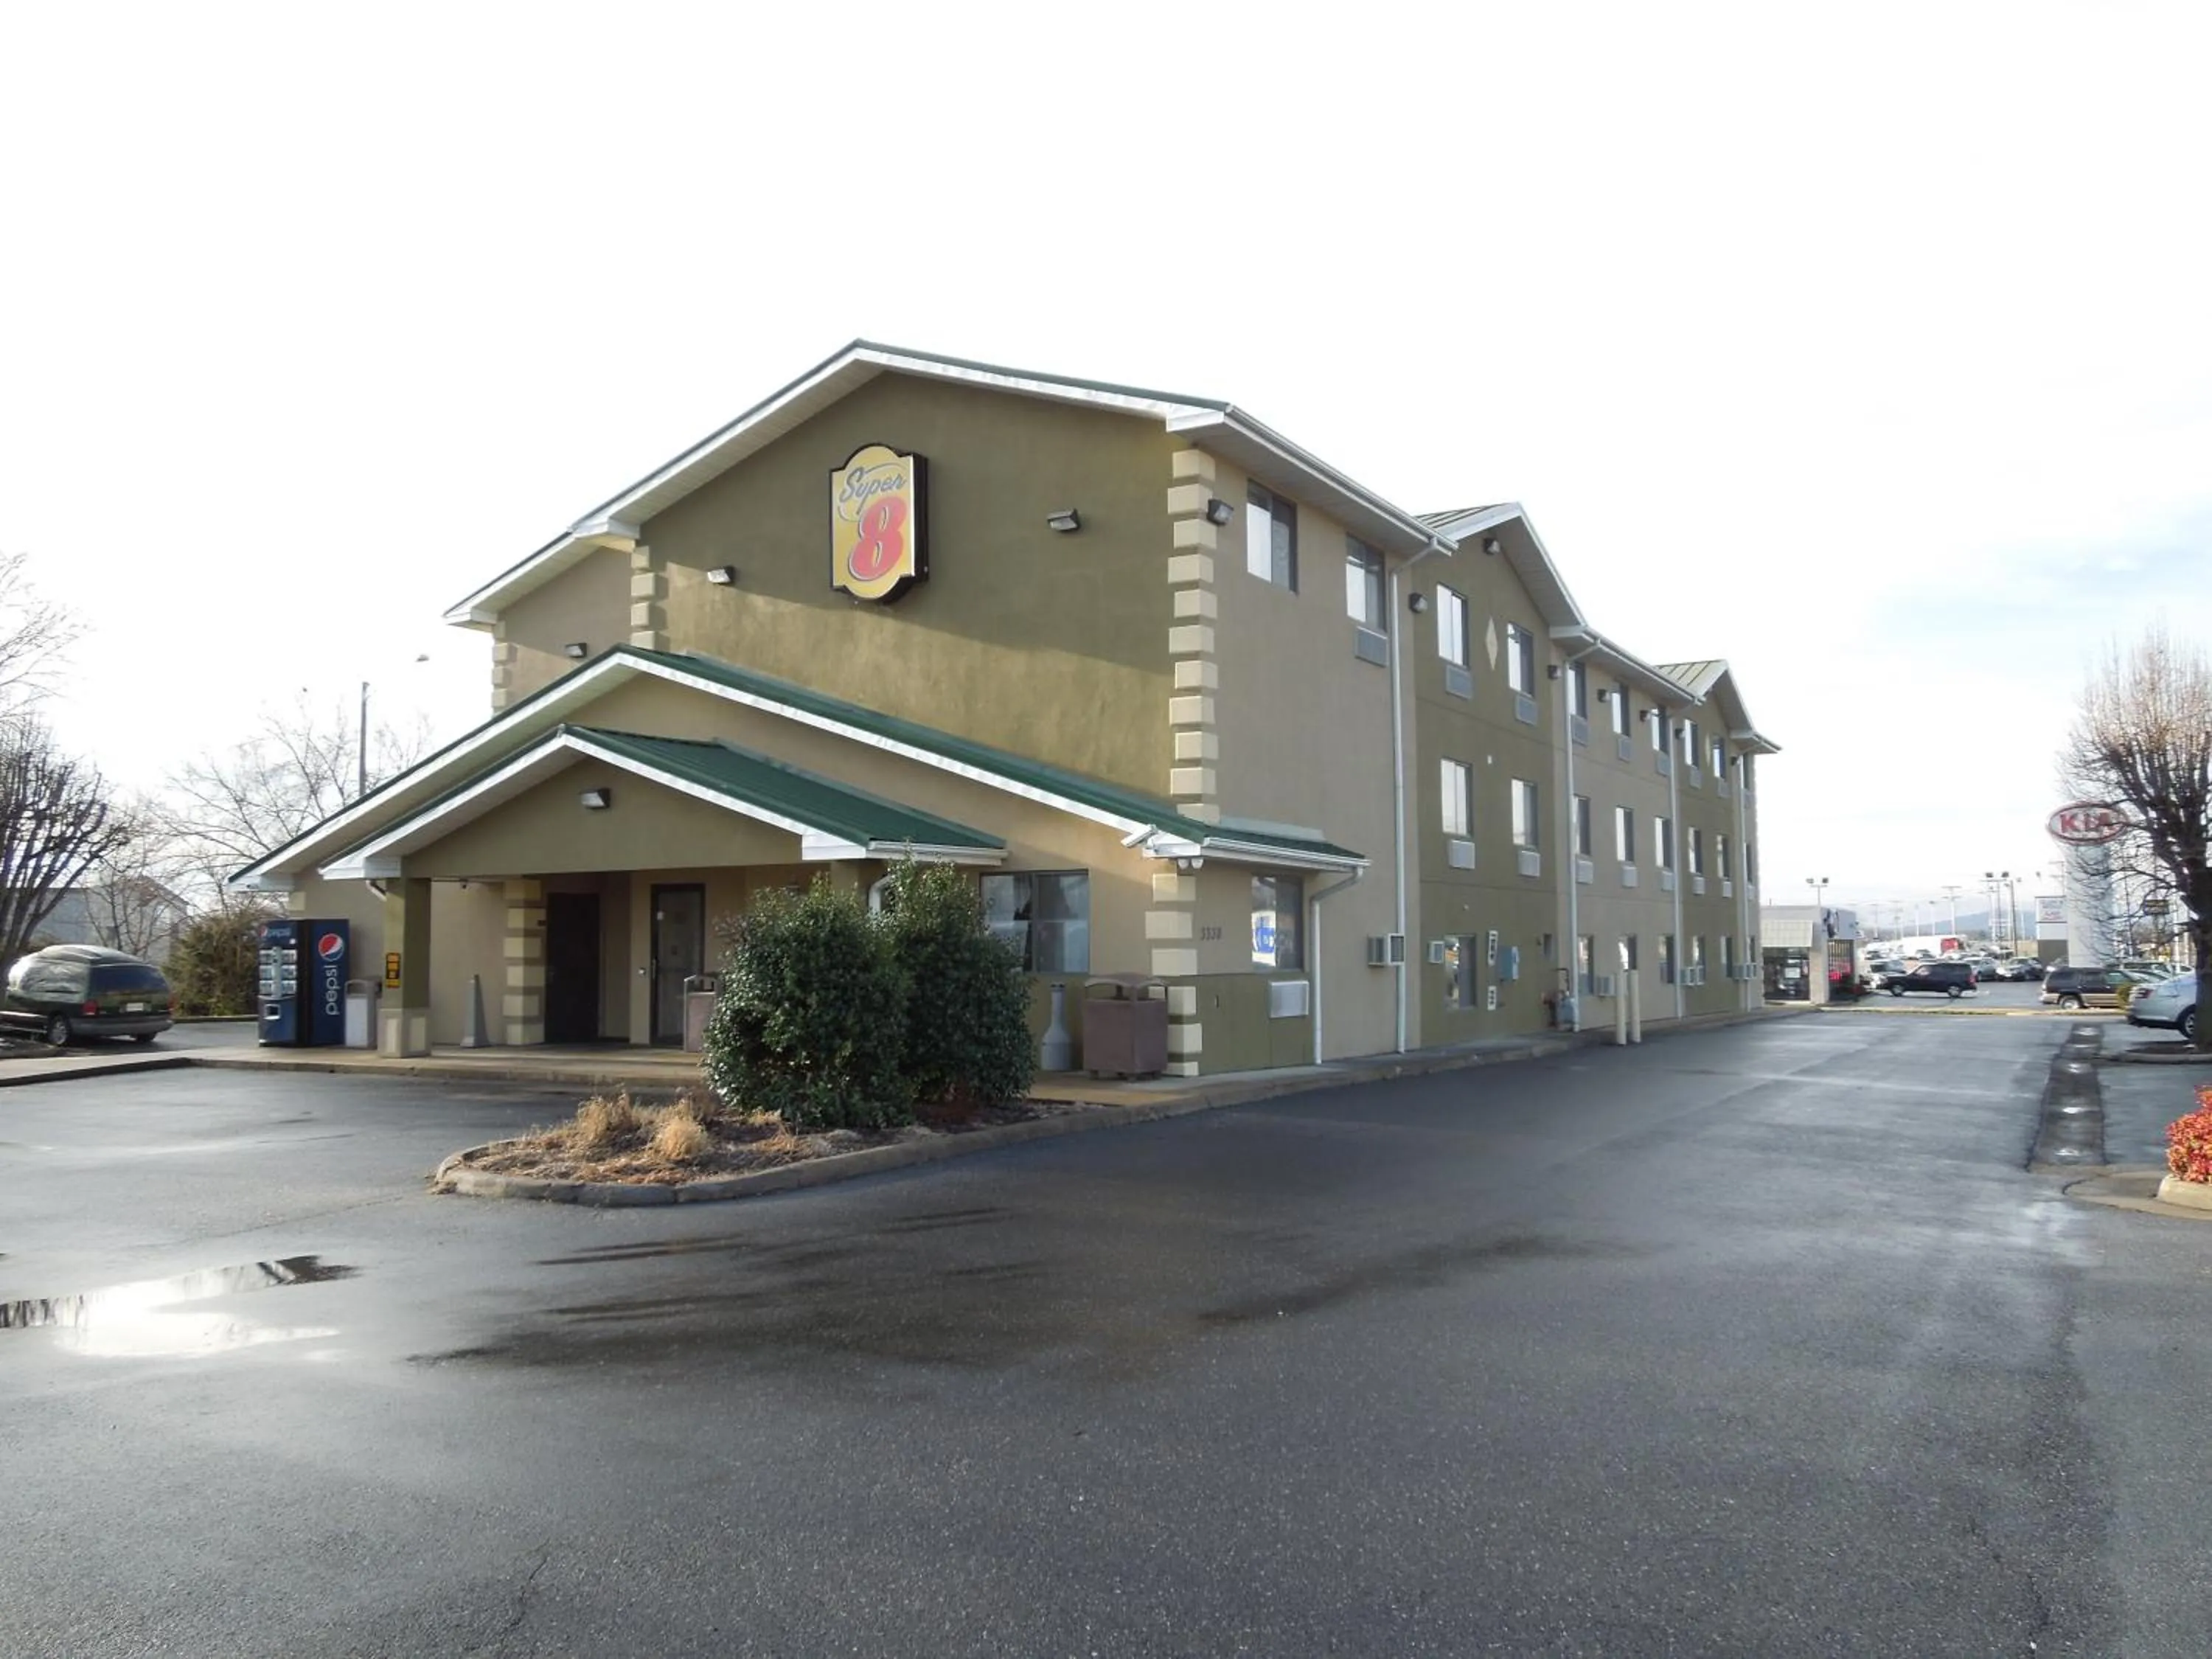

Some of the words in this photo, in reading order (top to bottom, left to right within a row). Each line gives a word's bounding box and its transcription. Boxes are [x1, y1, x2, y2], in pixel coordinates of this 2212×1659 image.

[839, 464, 907, 517] Super
[849, 496, 907, 582] 8
[323, 964, 341, 1015] pepsi
